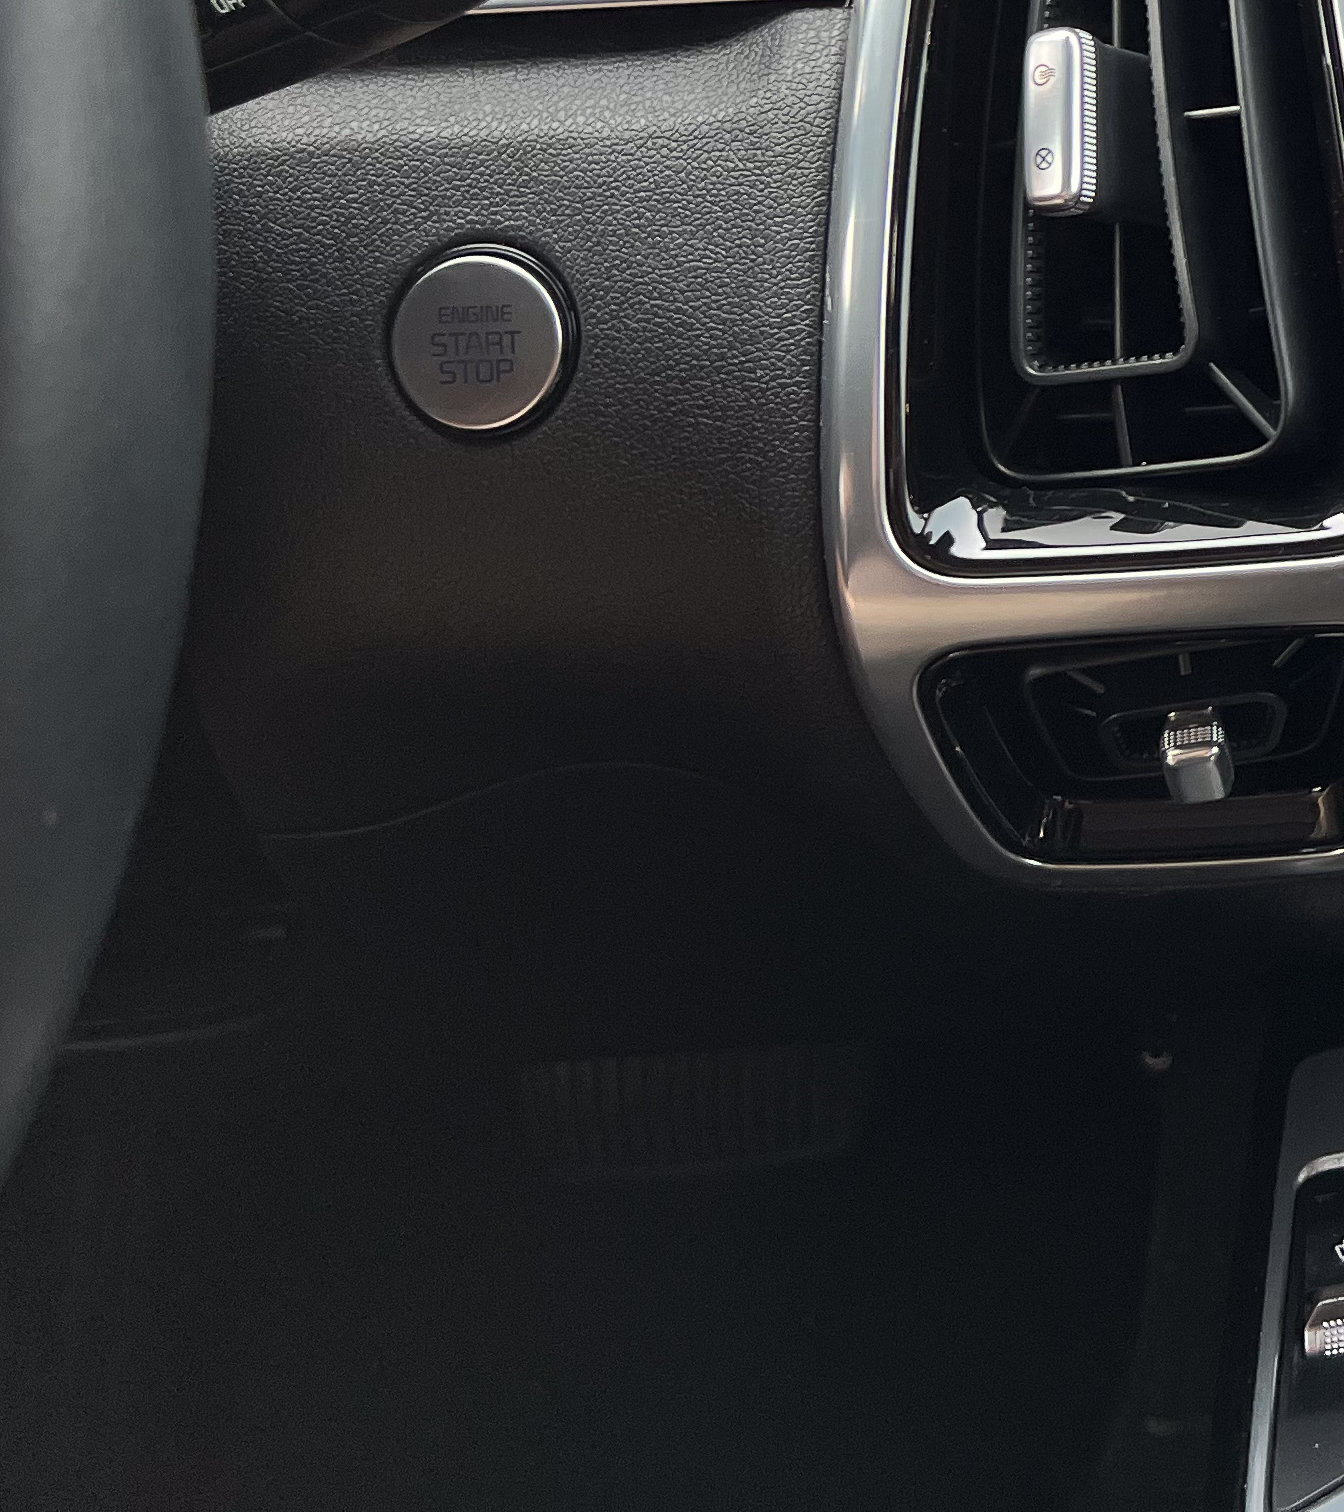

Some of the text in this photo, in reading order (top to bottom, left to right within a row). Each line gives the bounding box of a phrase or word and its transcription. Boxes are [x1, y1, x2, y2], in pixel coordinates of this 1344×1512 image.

[437, 304, 513, 325] ENGINE
[431, 330, 522, 357] START
[440, 359, 514, 385] STOP
